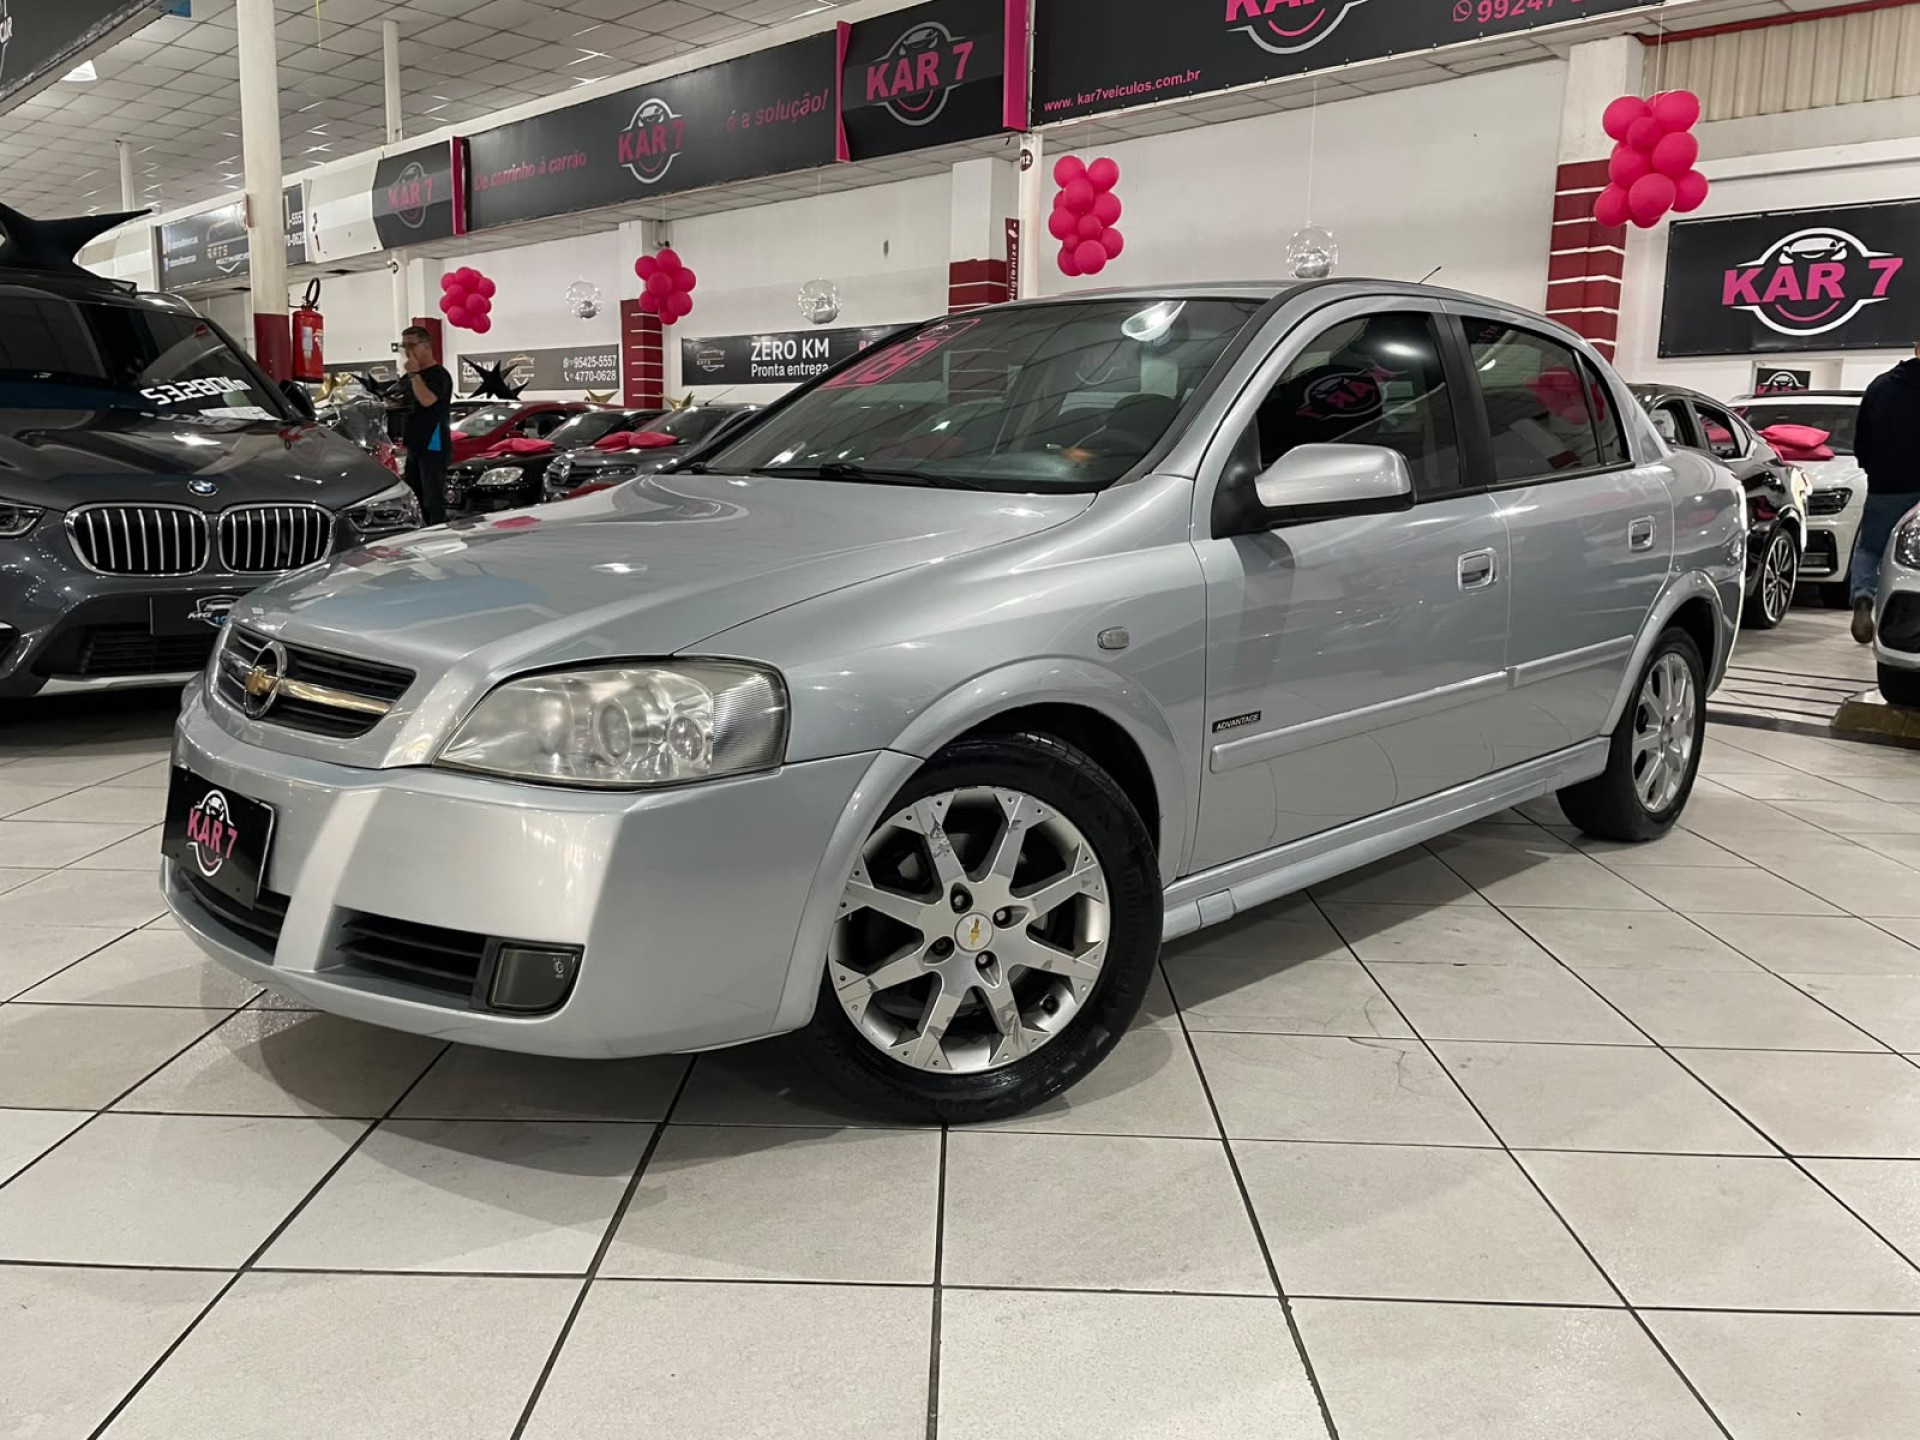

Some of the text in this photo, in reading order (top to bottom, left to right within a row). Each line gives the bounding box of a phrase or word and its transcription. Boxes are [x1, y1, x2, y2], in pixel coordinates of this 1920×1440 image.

[866, 41, 973, 101] KAR 7
[741, 113, 750, 128] a
[755, 89, 829, 123] solução!
[618, 118, 686, 163] KAR 7
[388, 182, 421, 209] KAR
[1722, 257, 1904, 305] KAR 7
[751, 337, 829, 361] ZERO KM
[751, 362, 785, 377] Pronta
[1216, 713, 1259, 730] ADVANTAGE
[187, 807, 238, 859] KAR 7
